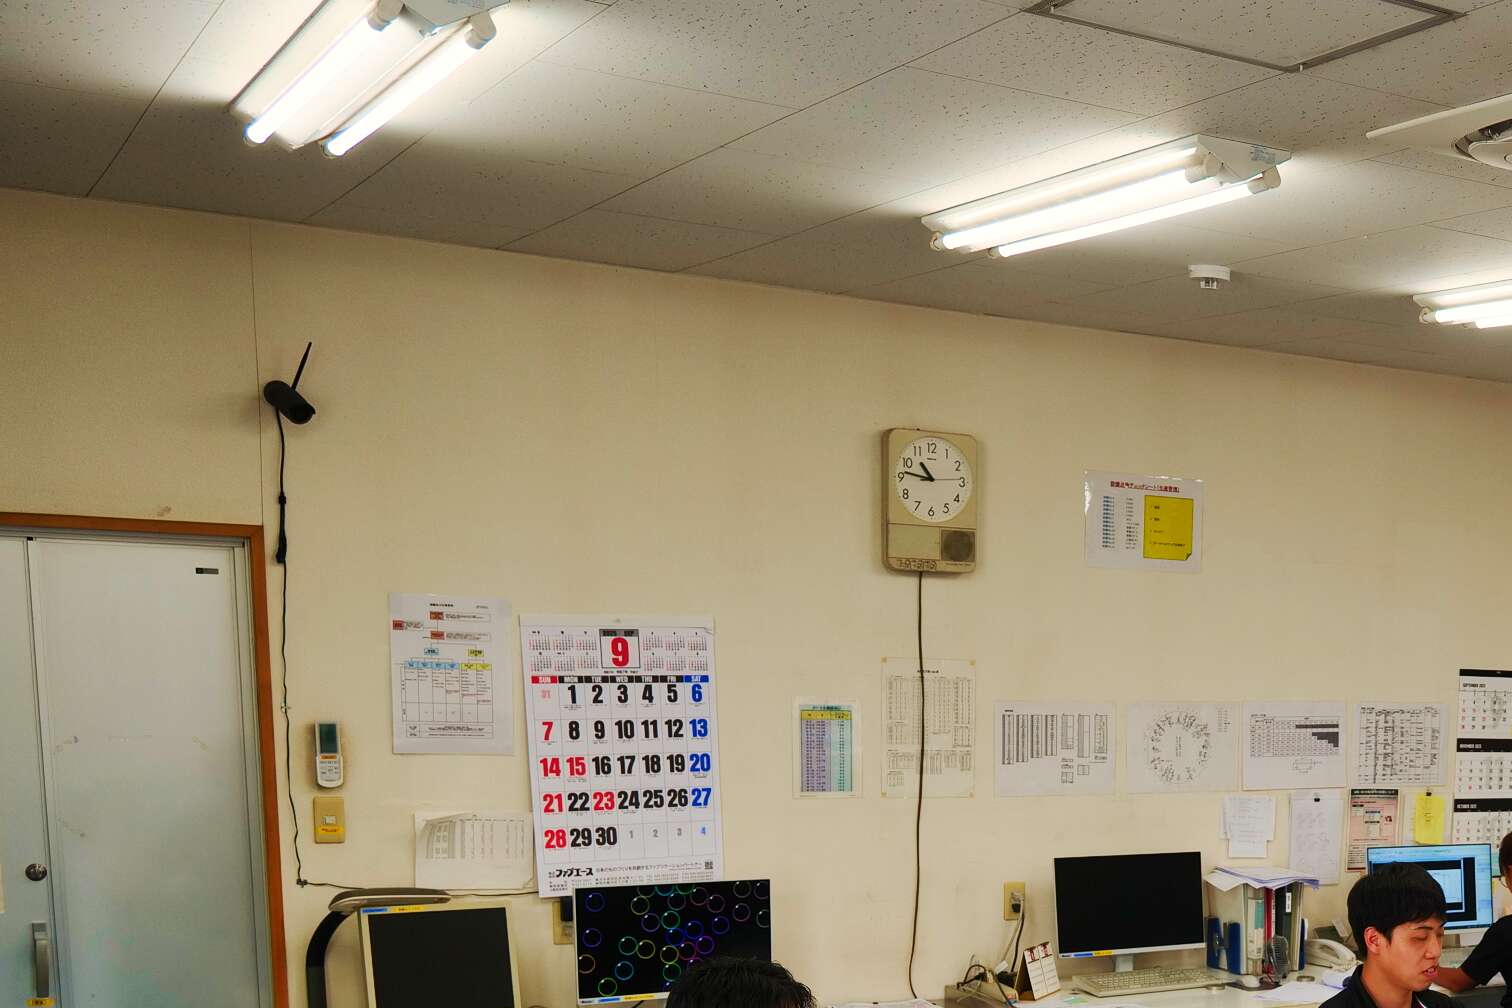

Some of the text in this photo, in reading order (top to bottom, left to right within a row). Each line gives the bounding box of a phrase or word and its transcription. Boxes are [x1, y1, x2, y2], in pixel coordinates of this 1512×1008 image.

[913, 445, 922, 457] 11
[926, 442, 937, 454] 12
[945, 448, 949, 460] 1
[902, 457, 913, 469] 10
[954, 460, 961, 472] 2
[897, 472, 905, 482] 9
[958, 476, 966, 488] 3
[902, 488, 909, 500] 8
[953, 493, 960, 503] 4
[914, 500, 921, 511] 7
[927, 506, 935, 517] 6
[942, 502, 950, 514] 5
[611, 637, 629, 667] 9
[567, 685, 577, 704] 1
[591, 685, 603, 704] 2
[617, 685, 629, 704] 3
[642, 685, 654, 703] 4
[667, 684, 678, 702] 5
[691, 684, 703, 702] 6
[542, 719, 708, 740] 7 8 9 10 11 12 13
[540, 753, 711, 777] 14 15 16 17 18 19 20
[543, 788, 712, 813] 21 22 23 24 25 26 27
[544, 829, 567, 849] 28
[570, 828, 592, 847] 29
[595, 827, 617, 846] 30
[653, 829, 659, 838] 2
[677, 828, 682, 837] 3
[700, 827, 706, 836] 4
[555, 867, 594, 878] ファブエース
